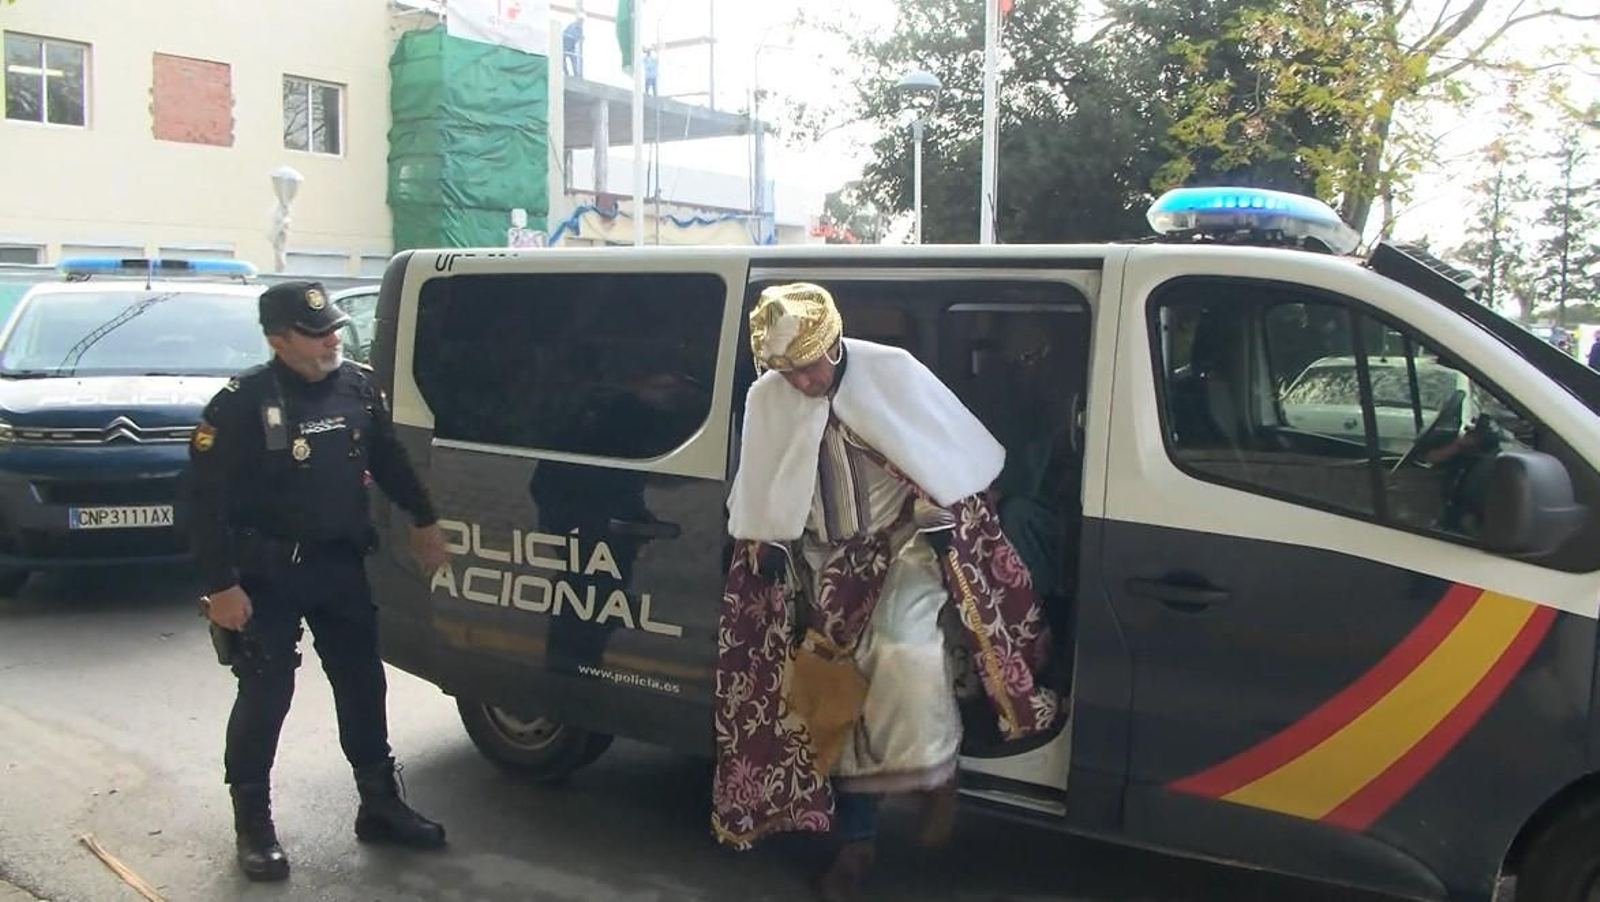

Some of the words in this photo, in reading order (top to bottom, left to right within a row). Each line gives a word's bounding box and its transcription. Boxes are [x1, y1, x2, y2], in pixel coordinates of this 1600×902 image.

[79, 507, 171, 526] CNP3111AX
[434, 518, 623, 581] OLICÍA
[430, 562, 684, 638] ACIONAL
[578, 664, 680, 693] www.policia.es
